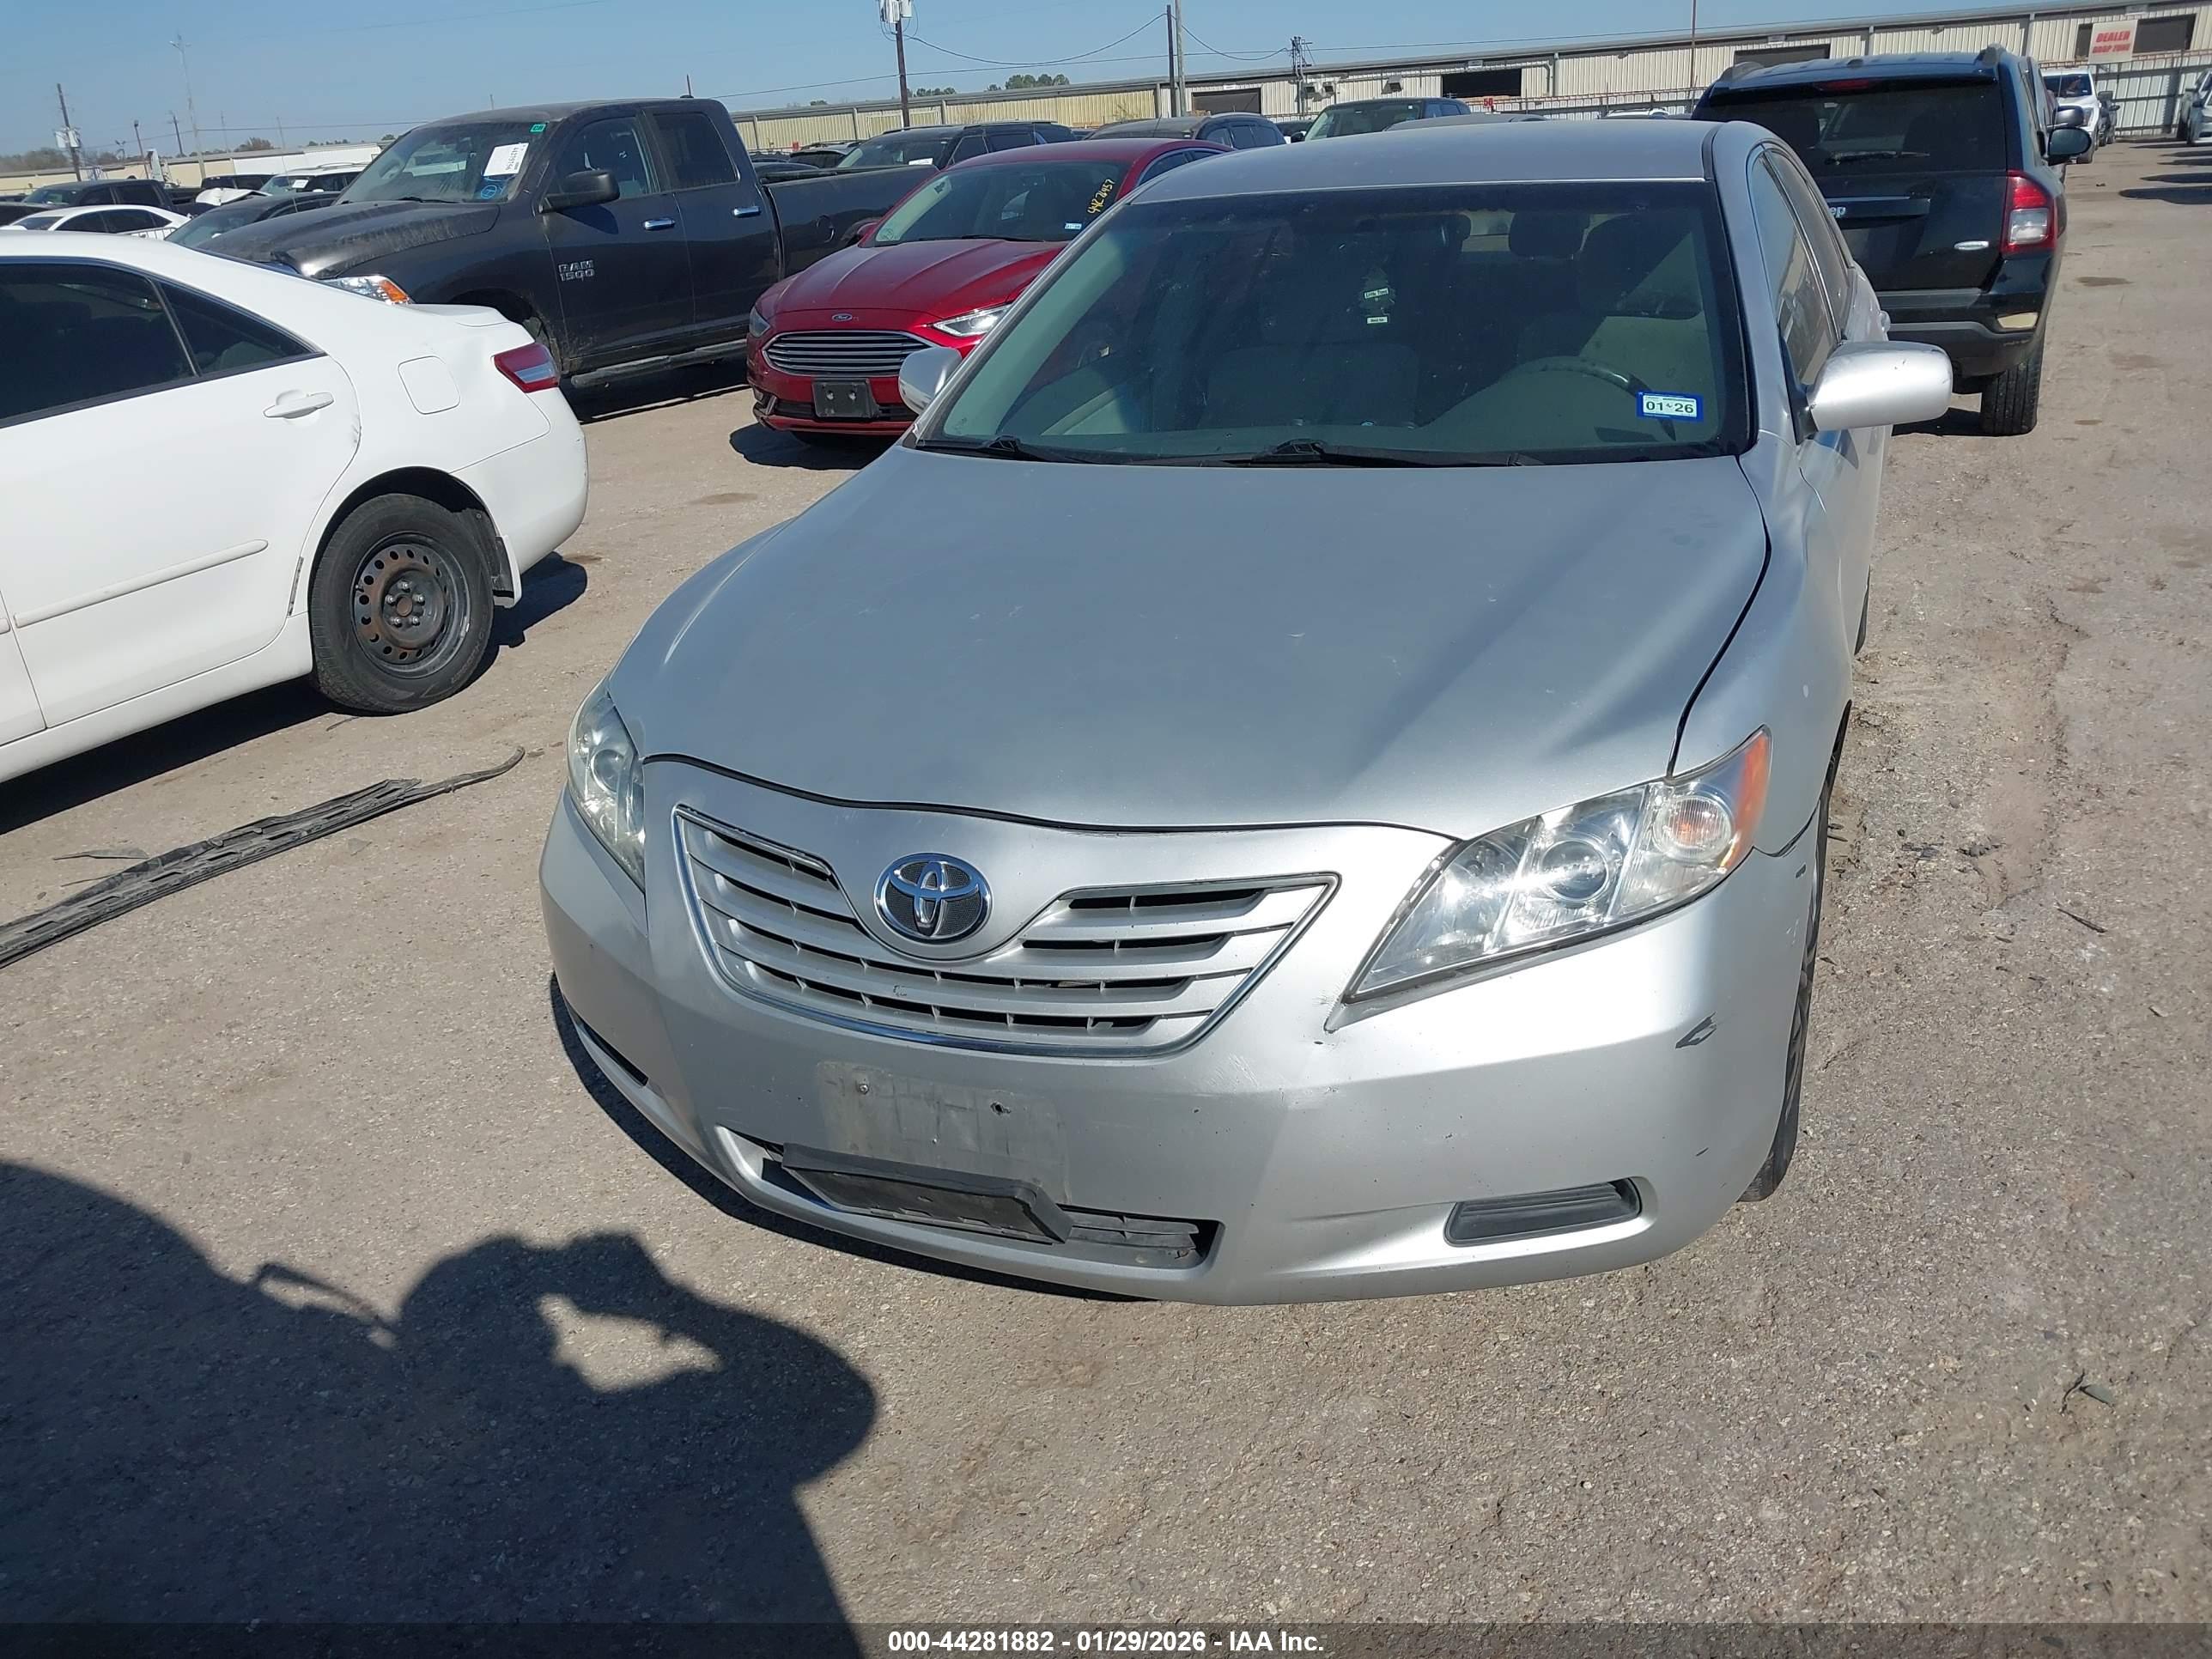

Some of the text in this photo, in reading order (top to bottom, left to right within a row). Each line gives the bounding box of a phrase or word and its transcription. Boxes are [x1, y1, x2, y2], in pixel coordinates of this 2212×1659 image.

[2095, 30, 2130, 42] DEALER
[1828, 206, 1846, 218] ep
[558, 259, 594, 272] RAM
[560, 269, 595, 281] 1500
[1645, 401, 1694, 413] 01 26
